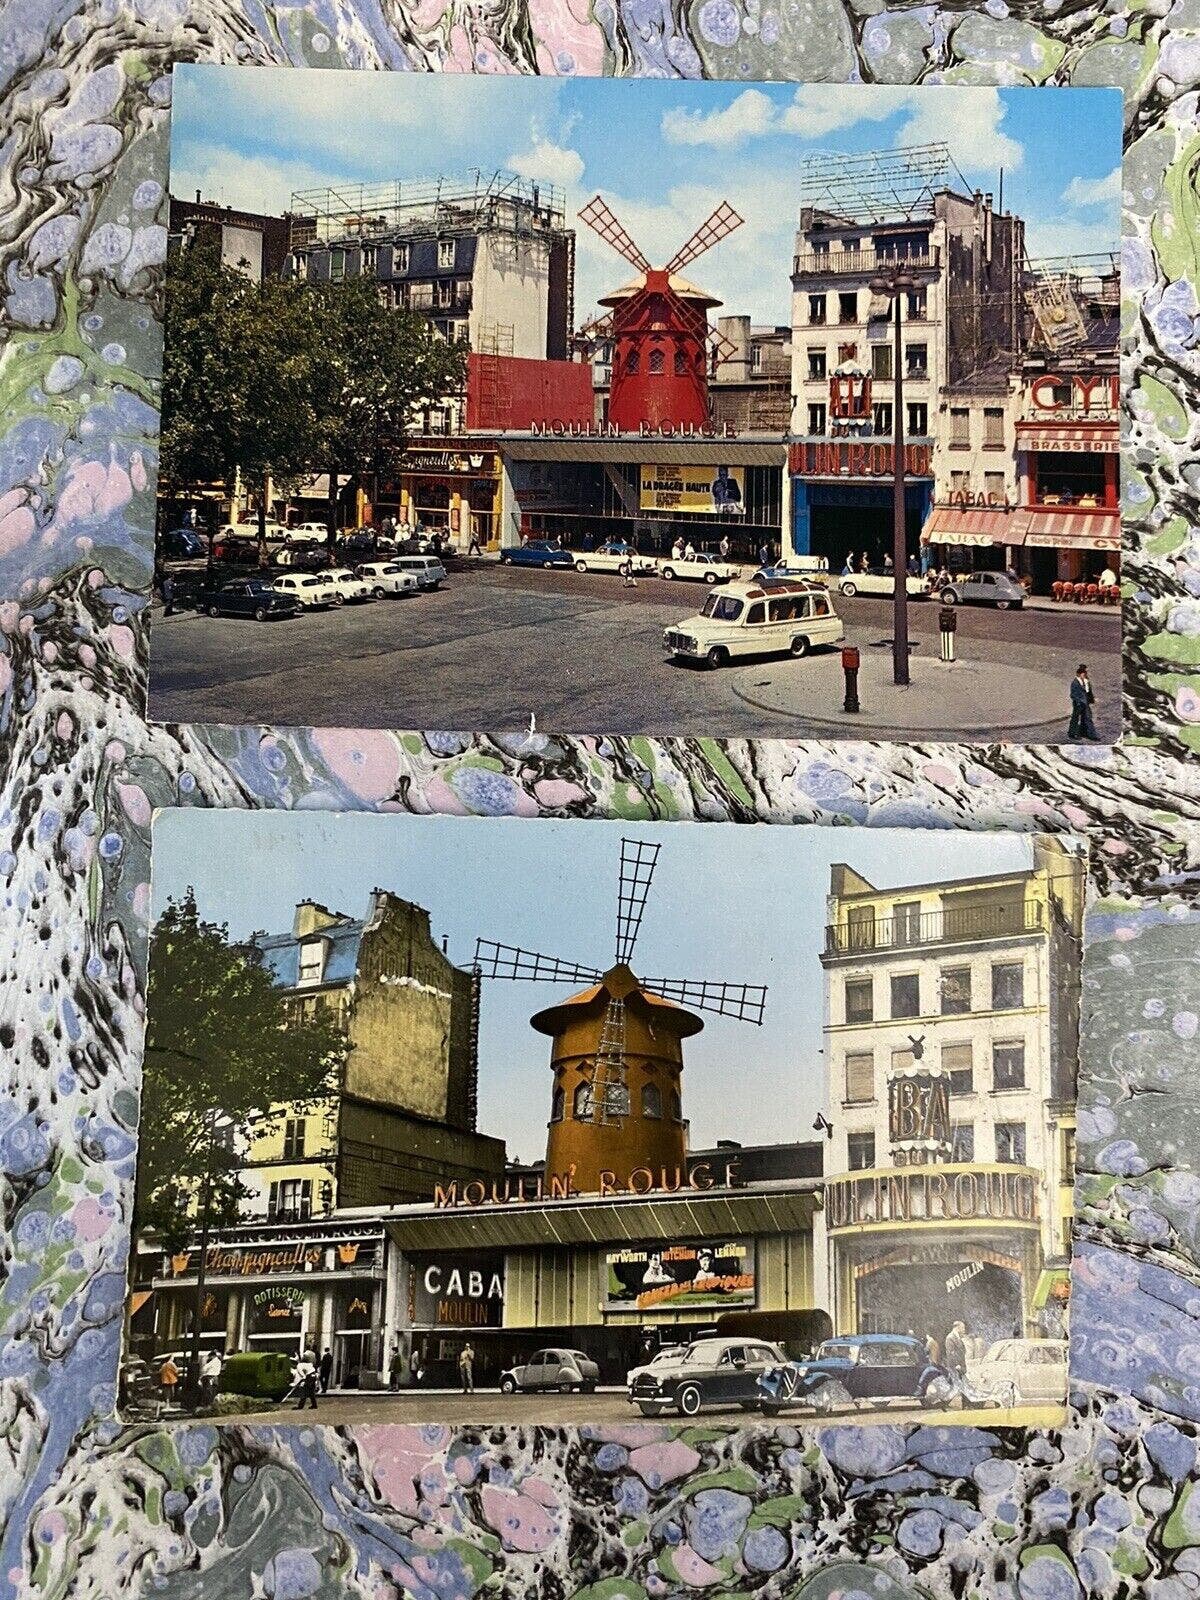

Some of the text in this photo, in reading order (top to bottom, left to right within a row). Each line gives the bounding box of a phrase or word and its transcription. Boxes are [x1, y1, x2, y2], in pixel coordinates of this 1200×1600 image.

[530, 419, 739, 438] MOULIN ROUGE
[1031, 440, 1119, 451] BRASSERIE
[642, 480, 652, 490] LA
[947, 491, 998, 507] TABAC
[937, 533, 989, 545] TABAC
[433, 1161, 742, 1209] MOULIN ROUGE
[606, 1251, 648, 1264] HAYWORTH
[424, 1265, 503, 1299] CABA
[945, 1260, 985, 1293] MOULIN
[436, 1300, 488, 1324] MOULIN
